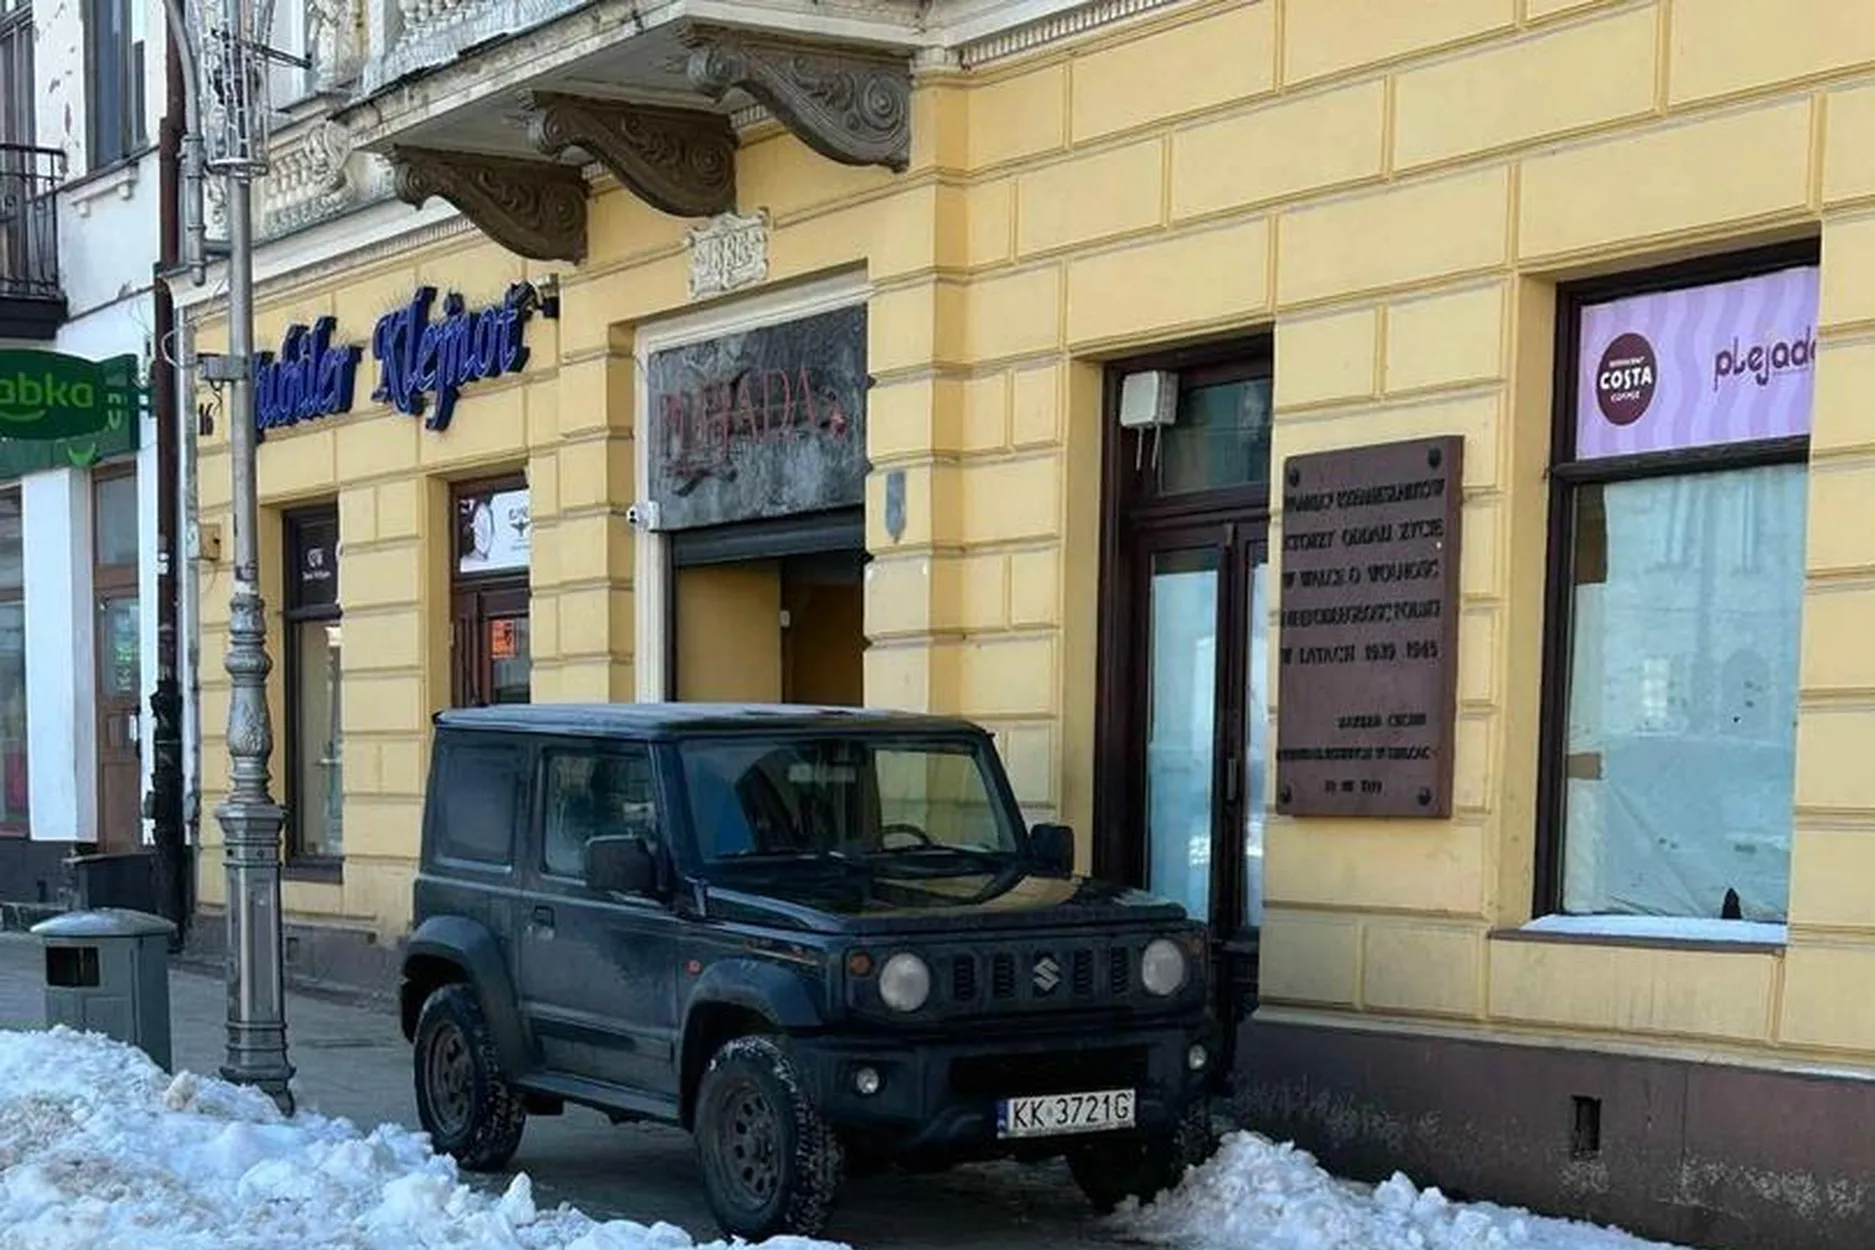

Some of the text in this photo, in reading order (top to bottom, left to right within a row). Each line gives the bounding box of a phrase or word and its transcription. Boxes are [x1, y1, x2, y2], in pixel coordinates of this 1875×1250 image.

[1600, 365, 1653, 390] COSTA
[1013, 1092, 1130, 1129] KK 3721G
